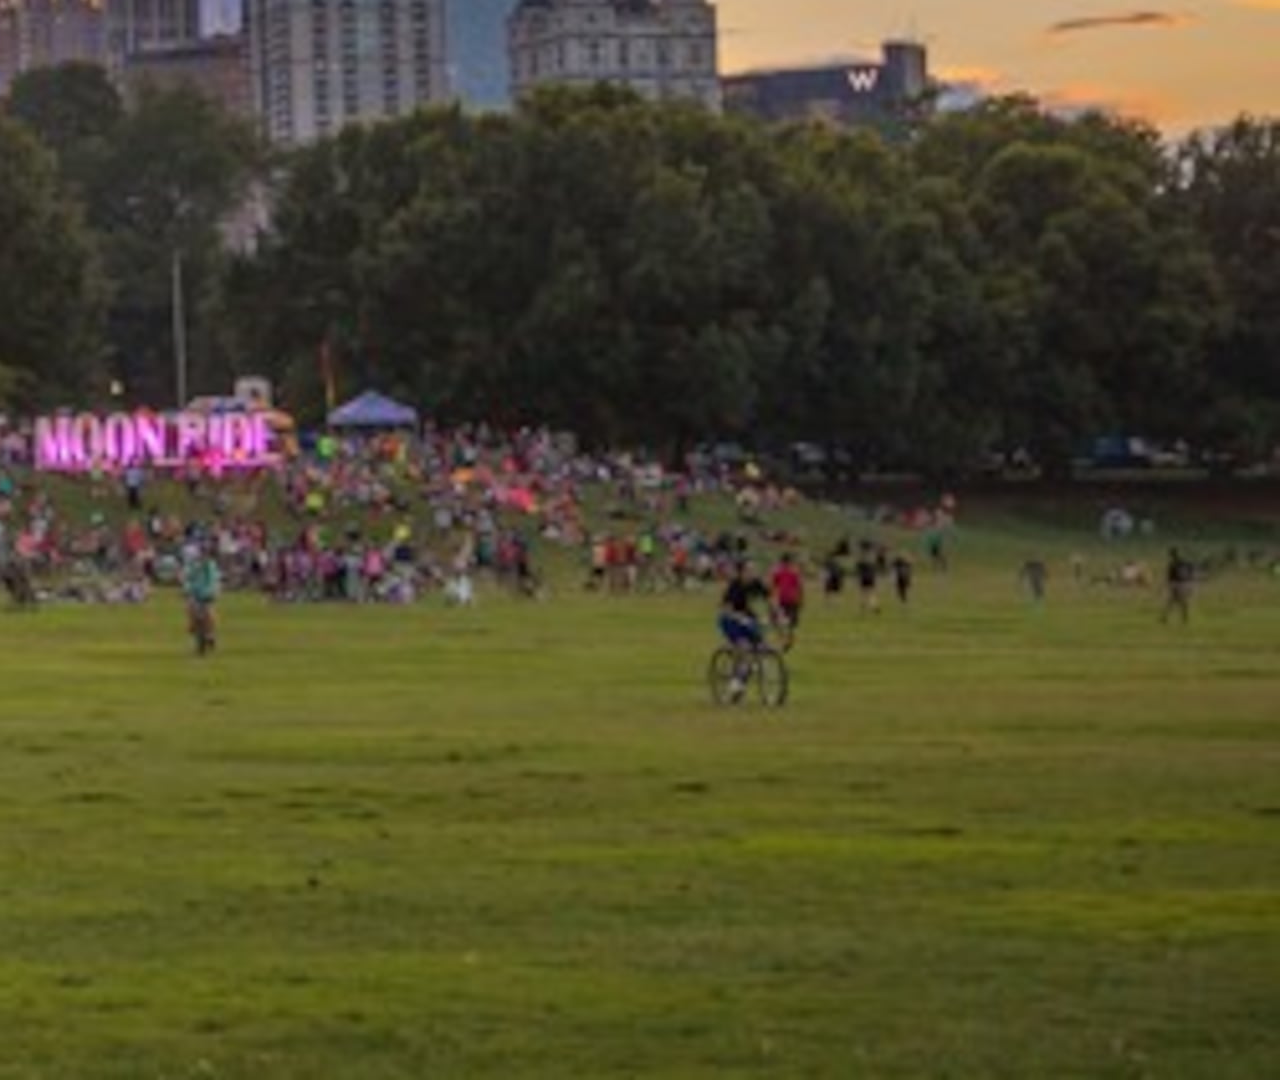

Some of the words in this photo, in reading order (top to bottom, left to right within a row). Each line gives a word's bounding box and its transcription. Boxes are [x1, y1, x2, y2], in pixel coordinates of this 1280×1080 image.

[848, 68, 877, 92] W
[34, 413, 166, 469] MOON
[178, 411, 281, 467] RIDE
